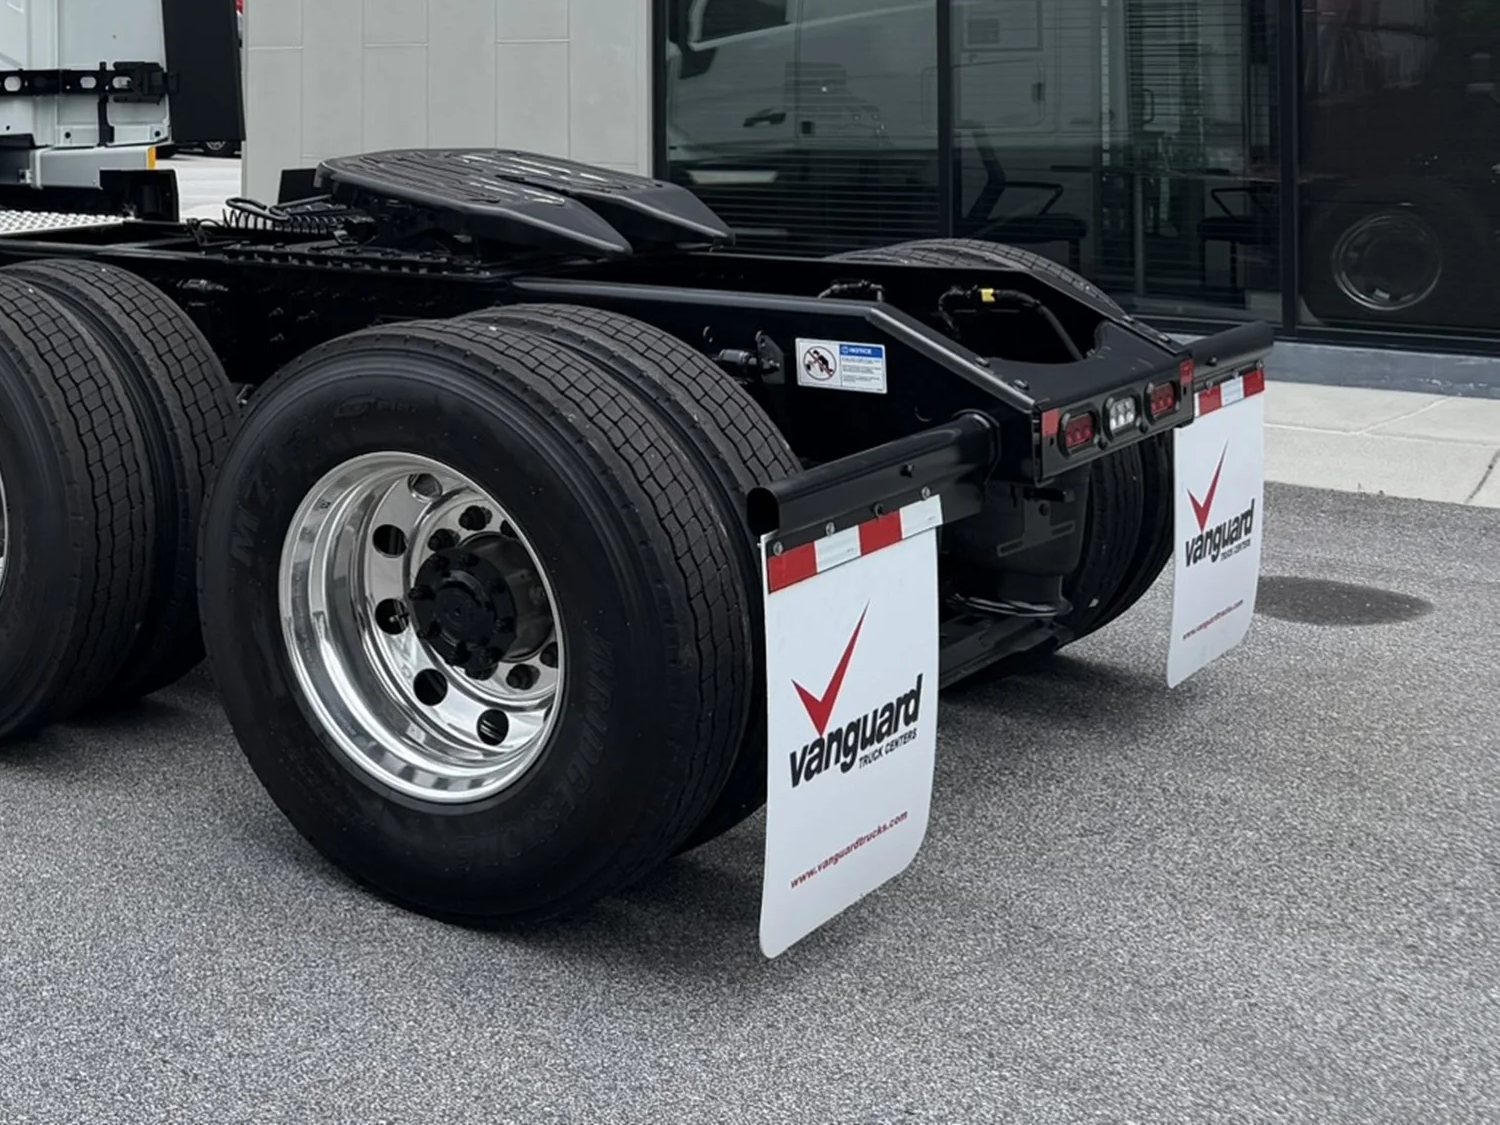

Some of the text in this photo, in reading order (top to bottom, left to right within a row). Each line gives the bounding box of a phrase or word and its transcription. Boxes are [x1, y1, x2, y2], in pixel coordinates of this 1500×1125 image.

[1185, 498, 1255, 567] vanguard
[789, 672, 924, 788] vanguard
[859, 727, 918, 769] TRUCK CENTERS
[790, 810, 908, 889] www.vanguardtrucks.com
